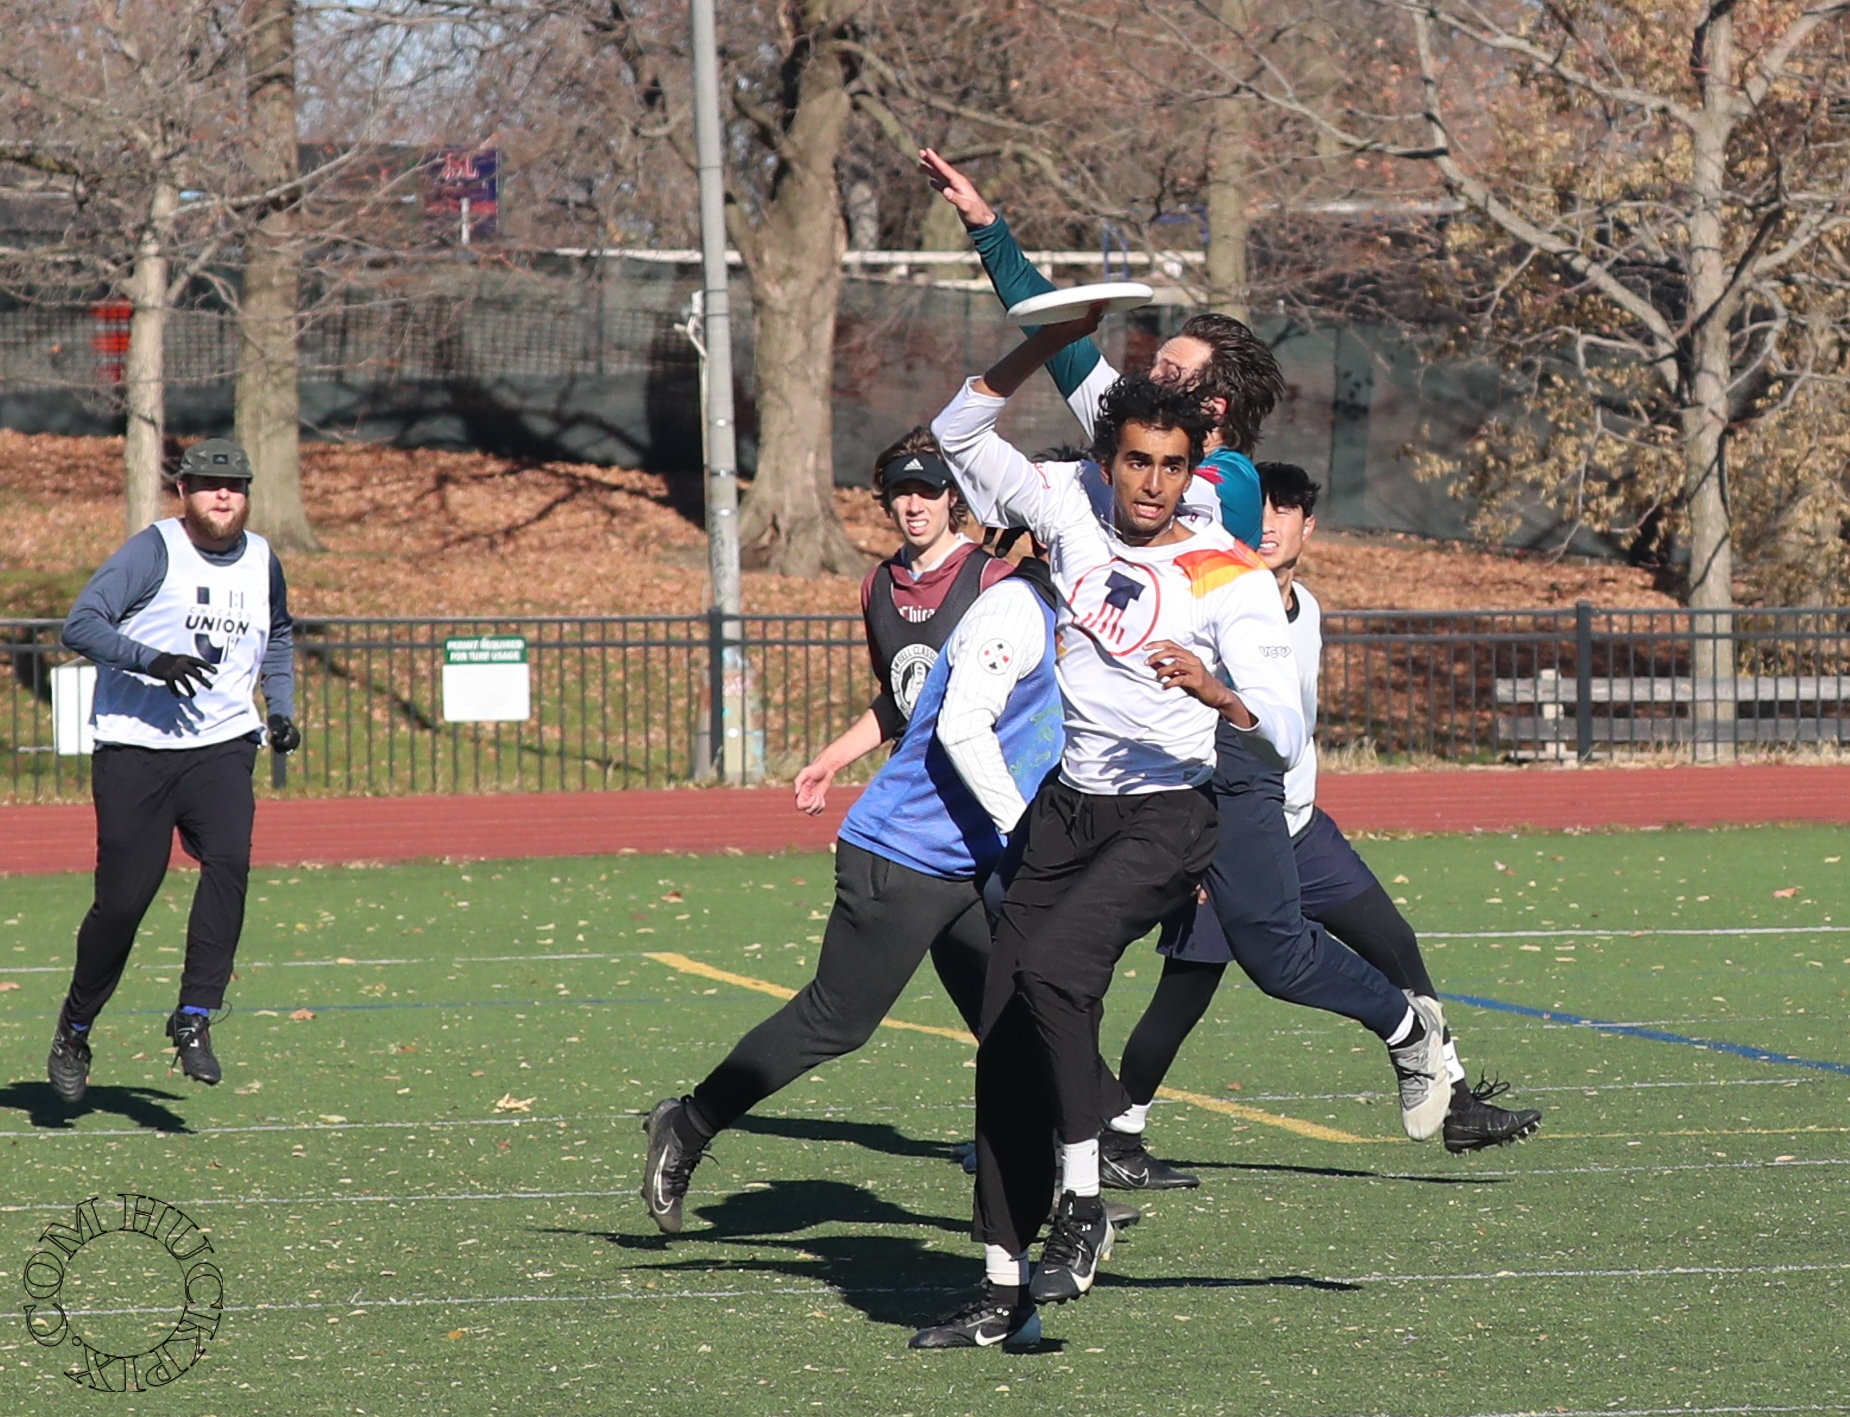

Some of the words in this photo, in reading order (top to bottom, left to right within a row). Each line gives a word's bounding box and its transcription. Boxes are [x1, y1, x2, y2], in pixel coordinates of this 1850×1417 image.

[188, 606, 252, 620] CHICAGO
[185, 614, 250, 635] UNION
[480, 639, 525, 650] REQUIRED
